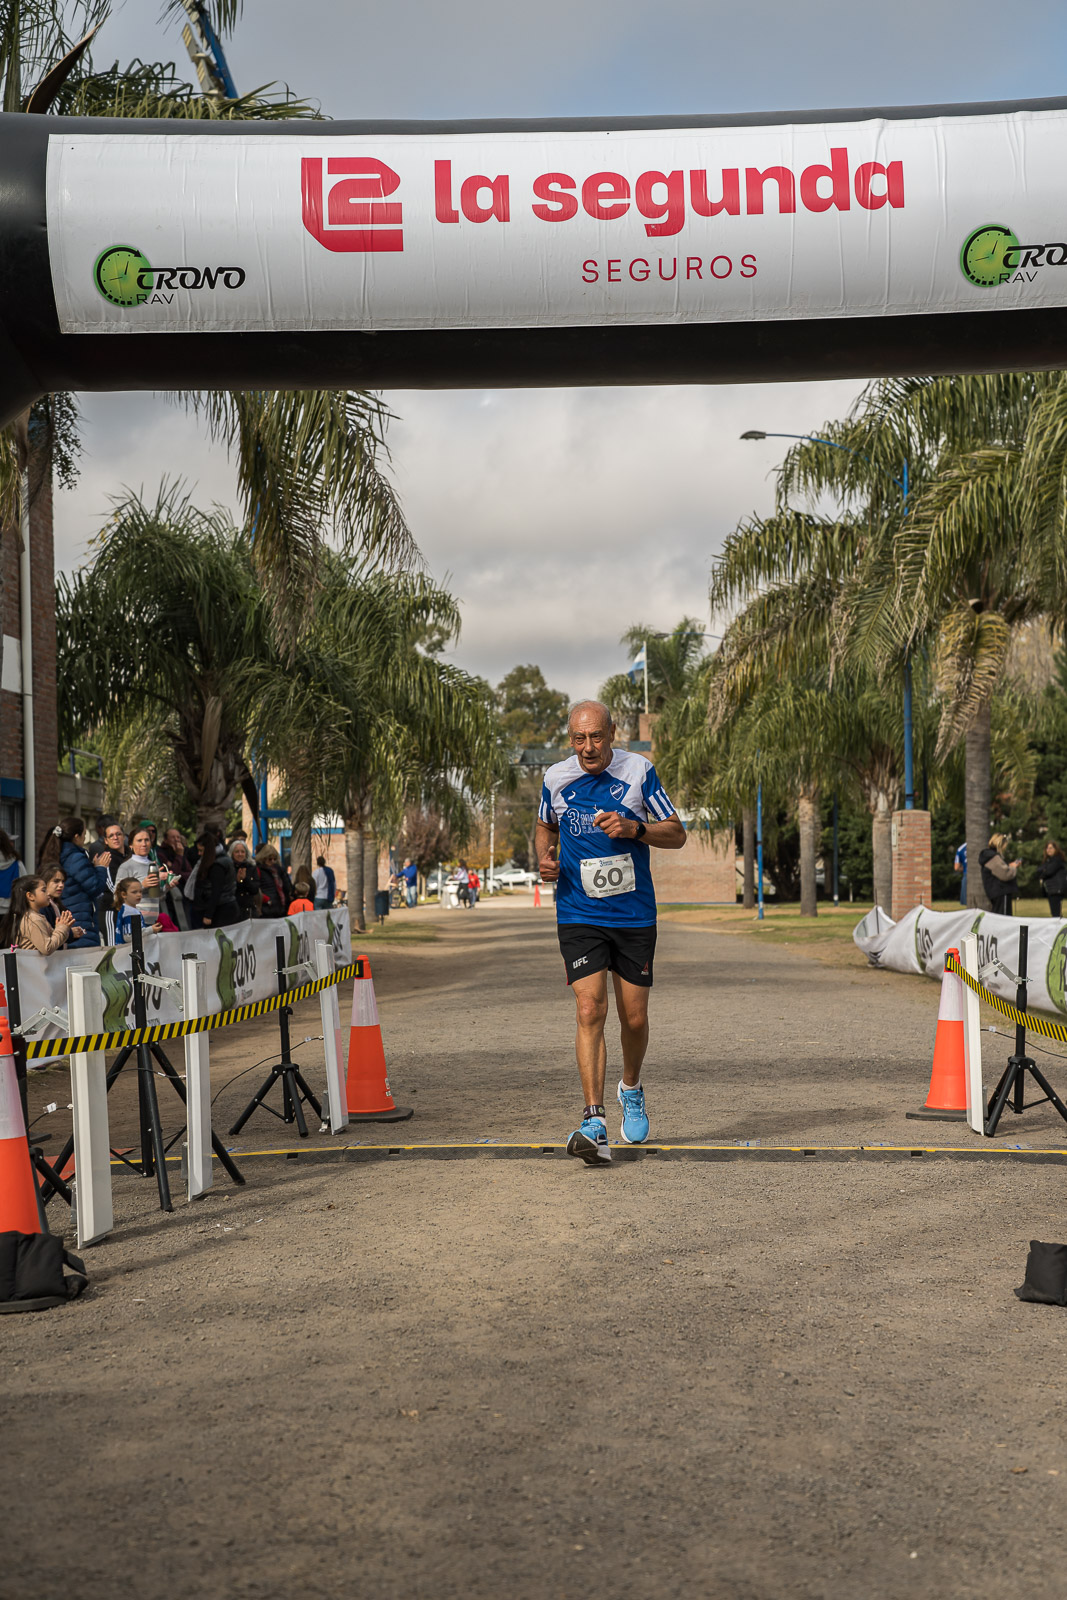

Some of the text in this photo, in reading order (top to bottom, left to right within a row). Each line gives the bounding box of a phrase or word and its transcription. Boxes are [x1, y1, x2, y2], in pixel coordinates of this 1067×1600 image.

[434, 148, 905, 237] la segunda
[136, 267, 246, 290] CRONO
[582, 254, 759, 283] SEGUROS
[998, 271, 1038, 284] RAV
[136, 293, 174, 305] RAV
[567, 808, 582, 837] 3
[593, 867, 623, 888] 60
[572, 956, 589, 969] UFC
